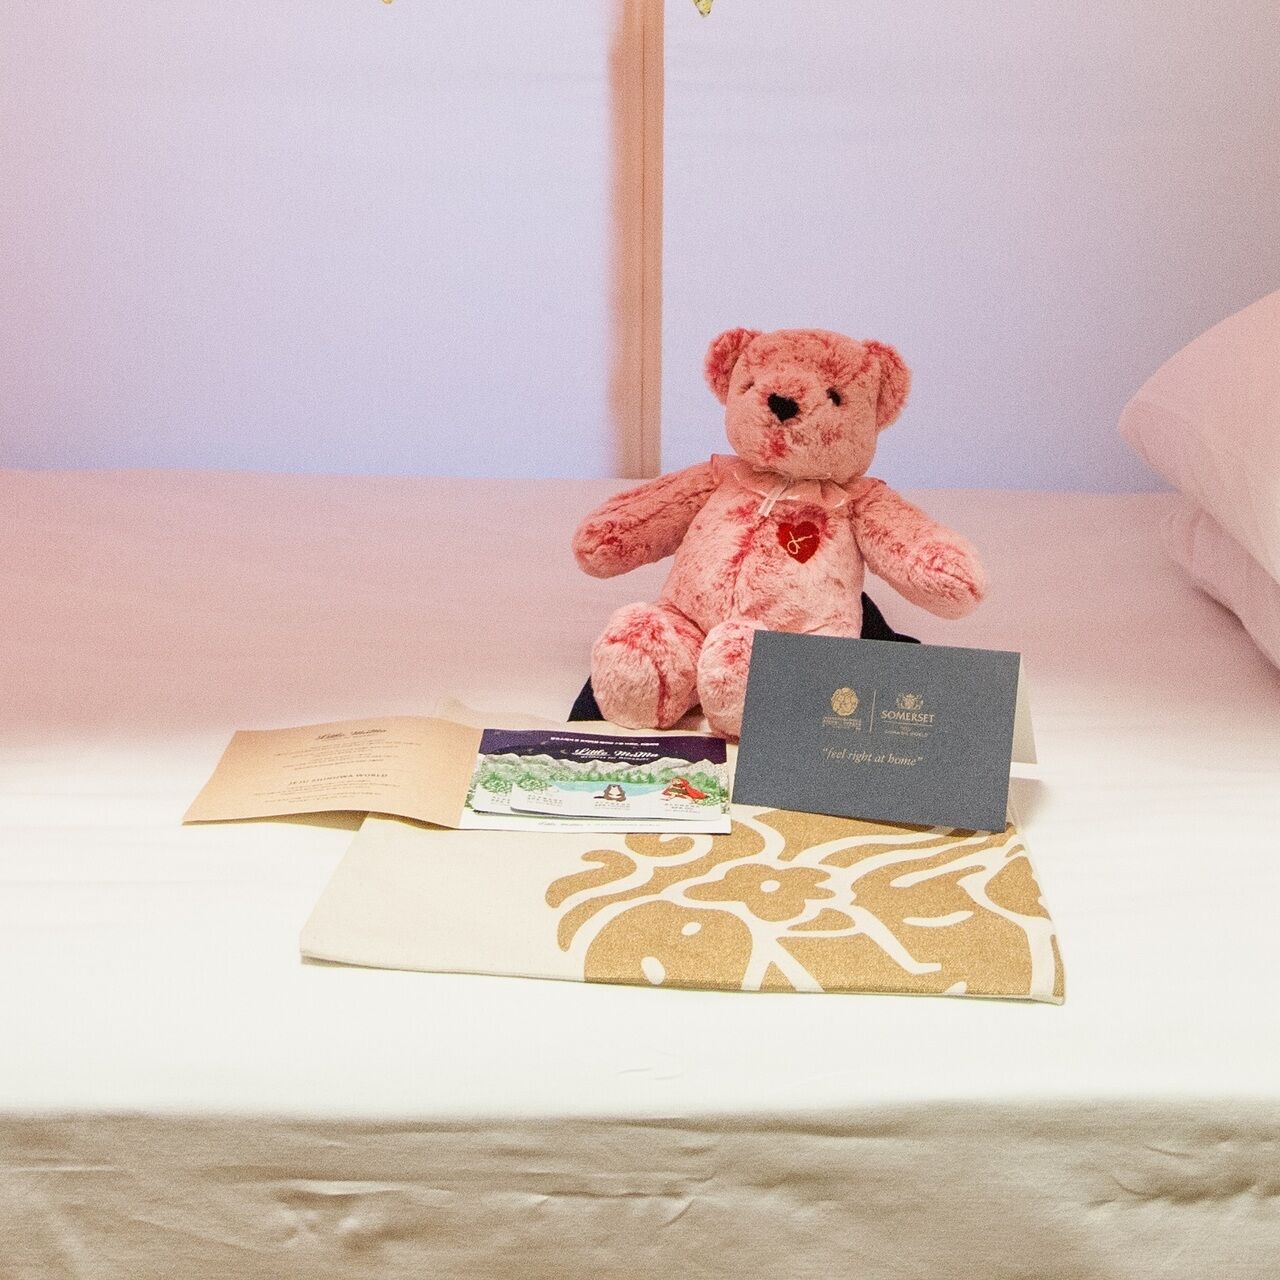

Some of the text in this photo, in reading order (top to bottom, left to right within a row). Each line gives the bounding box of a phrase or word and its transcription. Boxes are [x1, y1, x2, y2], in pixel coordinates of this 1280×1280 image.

[881, 710, 935, 723] SOMERSET
[847, 750, 873, 764] right
[874, 754, 886, 763] at
